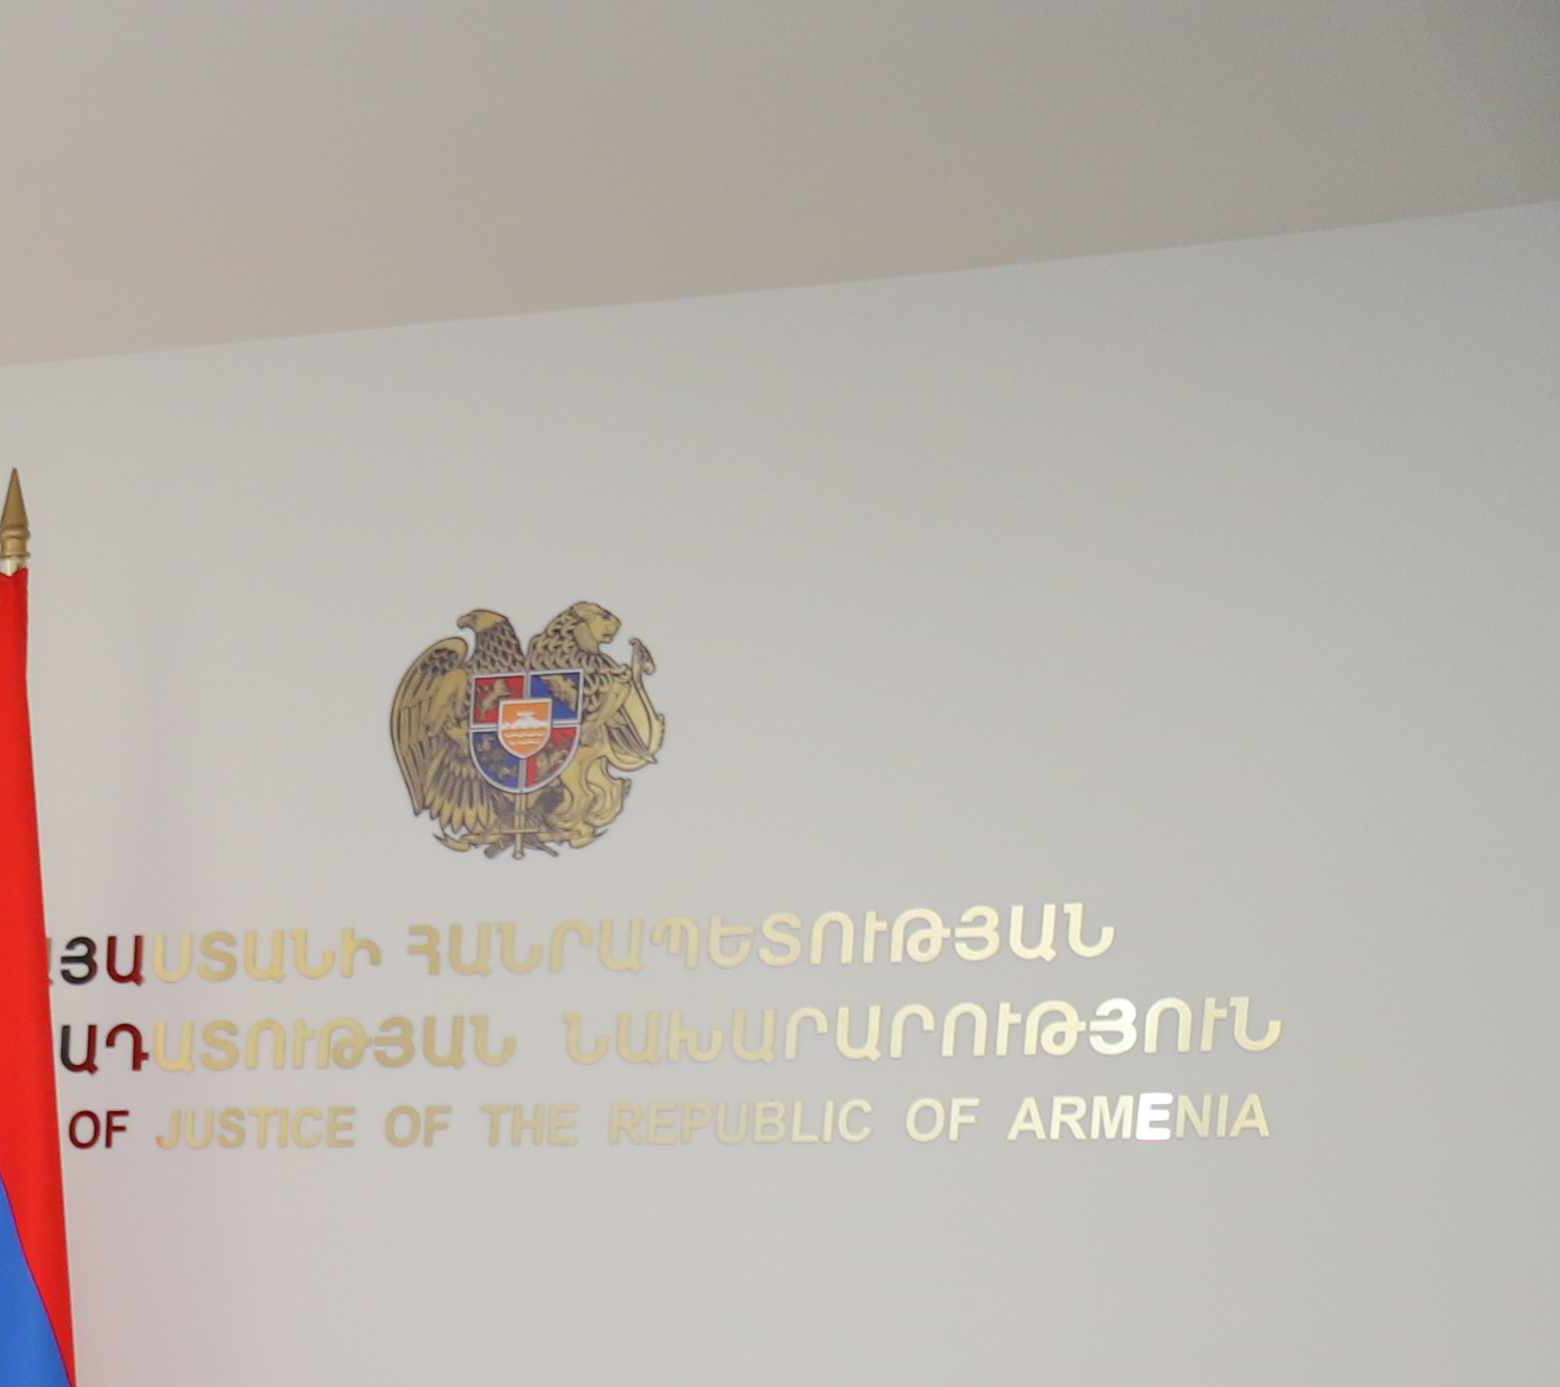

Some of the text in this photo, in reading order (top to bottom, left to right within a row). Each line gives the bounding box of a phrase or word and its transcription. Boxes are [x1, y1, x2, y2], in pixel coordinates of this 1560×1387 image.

[49, 903, 1114, 986] ՅԱՍՏԱՆԻ ՀԱՆՐԱՊԵՏՈՒԹՅԱՆ
[562, 996, 1282, 1065] ՆԱԽԱՐԱՐՈՒԹՅՈՒՆ
[69, 1092, 1270, 1149] OF JUSTICE OF THE REPUBLIC OF ARMENIA
